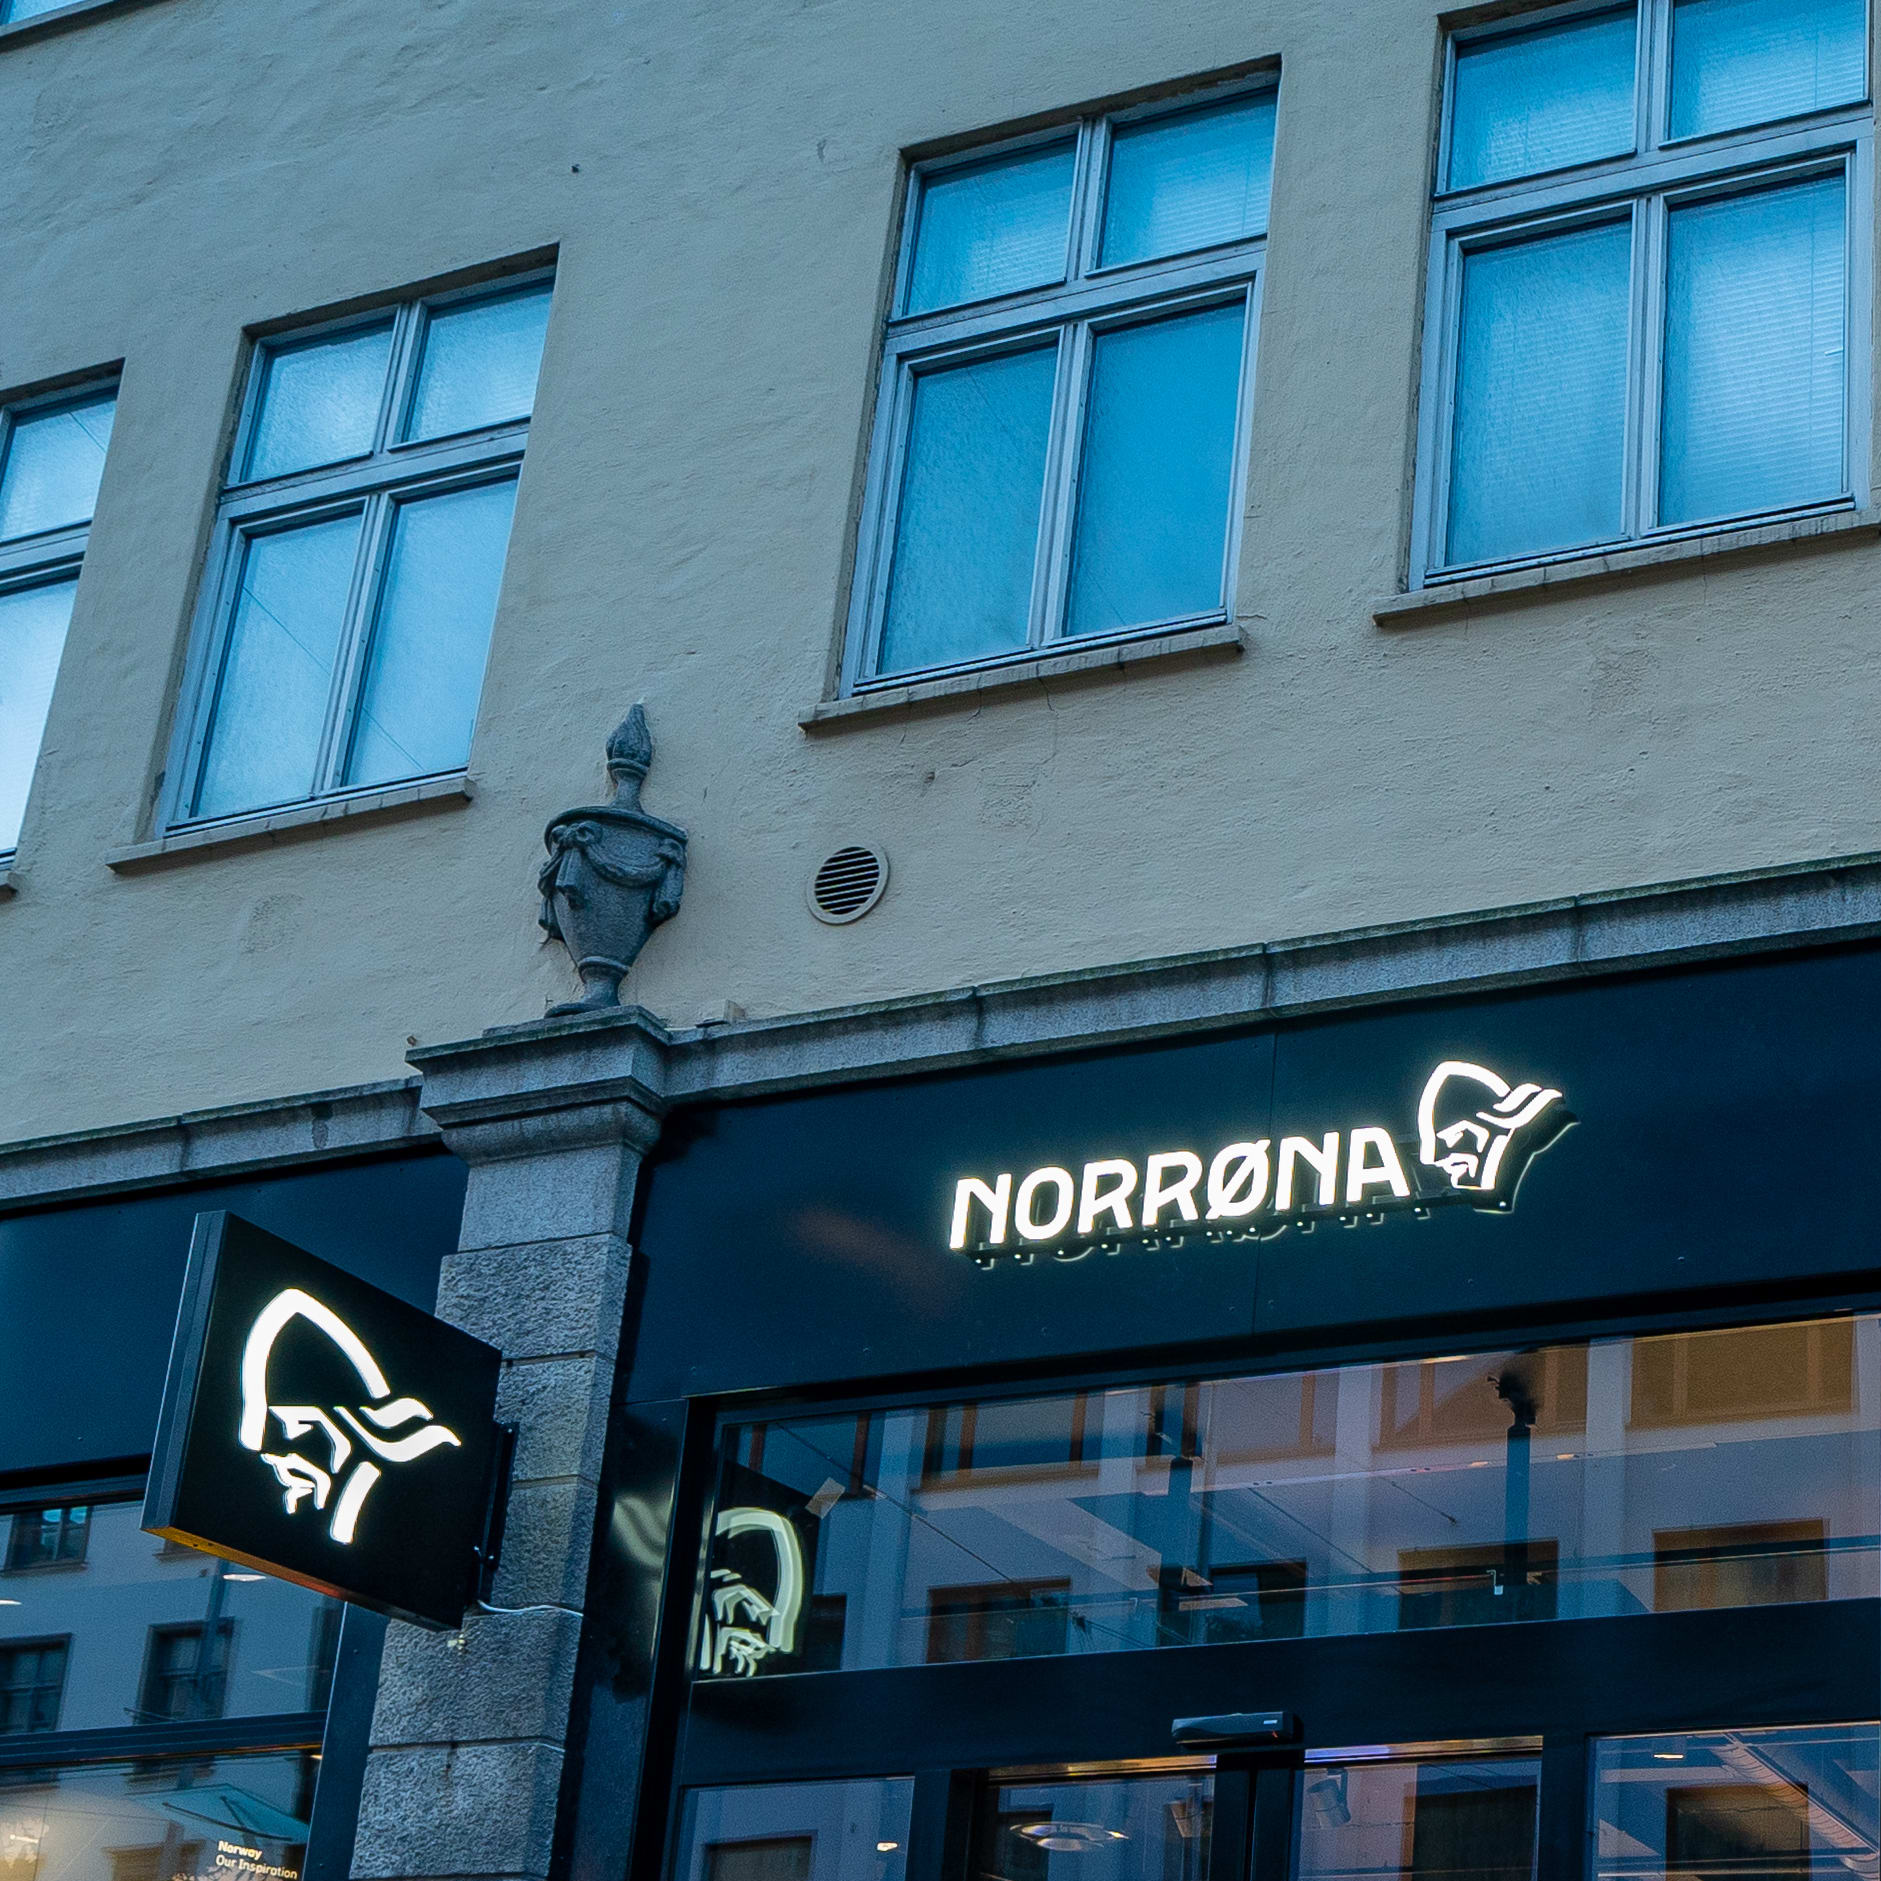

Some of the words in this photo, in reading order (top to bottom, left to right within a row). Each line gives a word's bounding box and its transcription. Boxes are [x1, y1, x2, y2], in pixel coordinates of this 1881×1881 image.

[949, 1127, 1410, 1250] NORRØNA
[217, 1840, 262, 1860] Norway
[216, 1854, 236, 1868] Our
[238, 1858, 298, 1880] Inspiration
